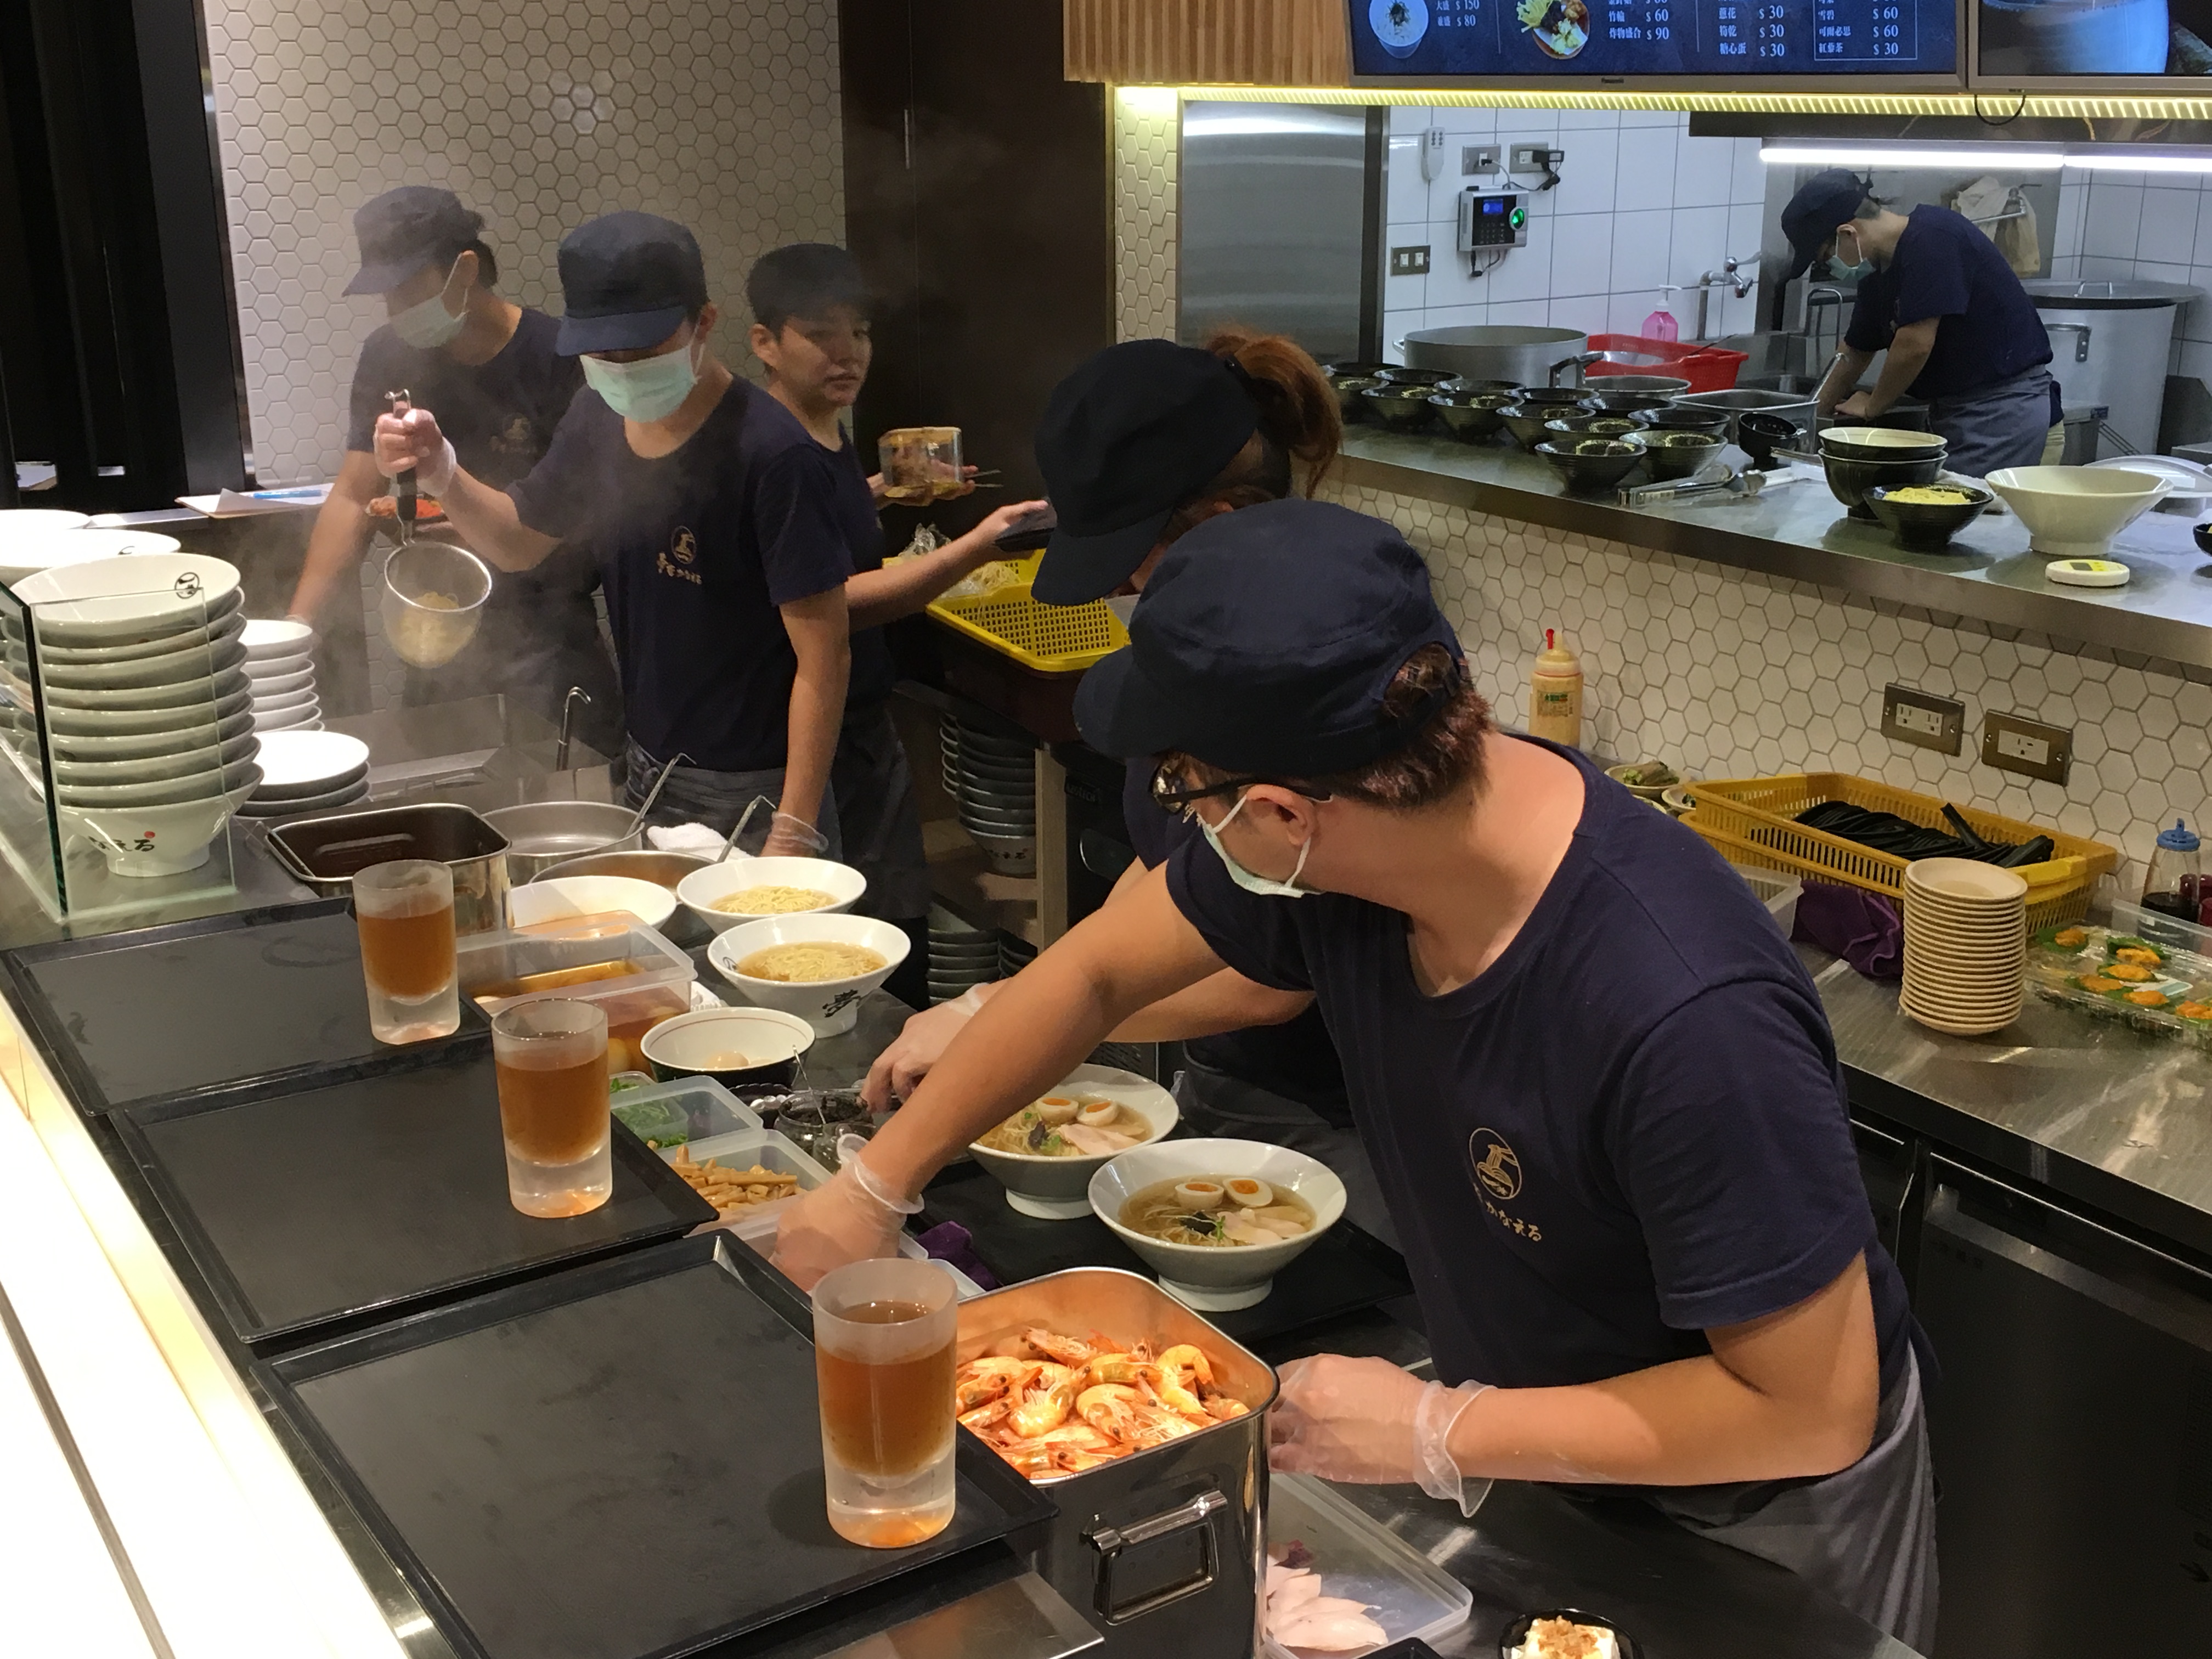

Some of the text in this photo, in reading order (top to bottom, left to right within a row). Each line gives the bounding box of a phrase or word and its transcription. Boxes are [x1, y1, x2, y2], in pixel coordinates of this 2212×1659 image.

[1655, 8, 1668, 22] 60
[1769, 5, 1784, 19] 30
[1883, 6, 1898, 19] 60
[1464, 14, 1476, 26] 80
[1655, 26, 1669, 40] 90
[1769, 24, 1784, 38] 30
[1883, 24, 1898, 37] 60
[1770, 43, 1785, 57] 30
[1884, 42, 1898, 55] 30
